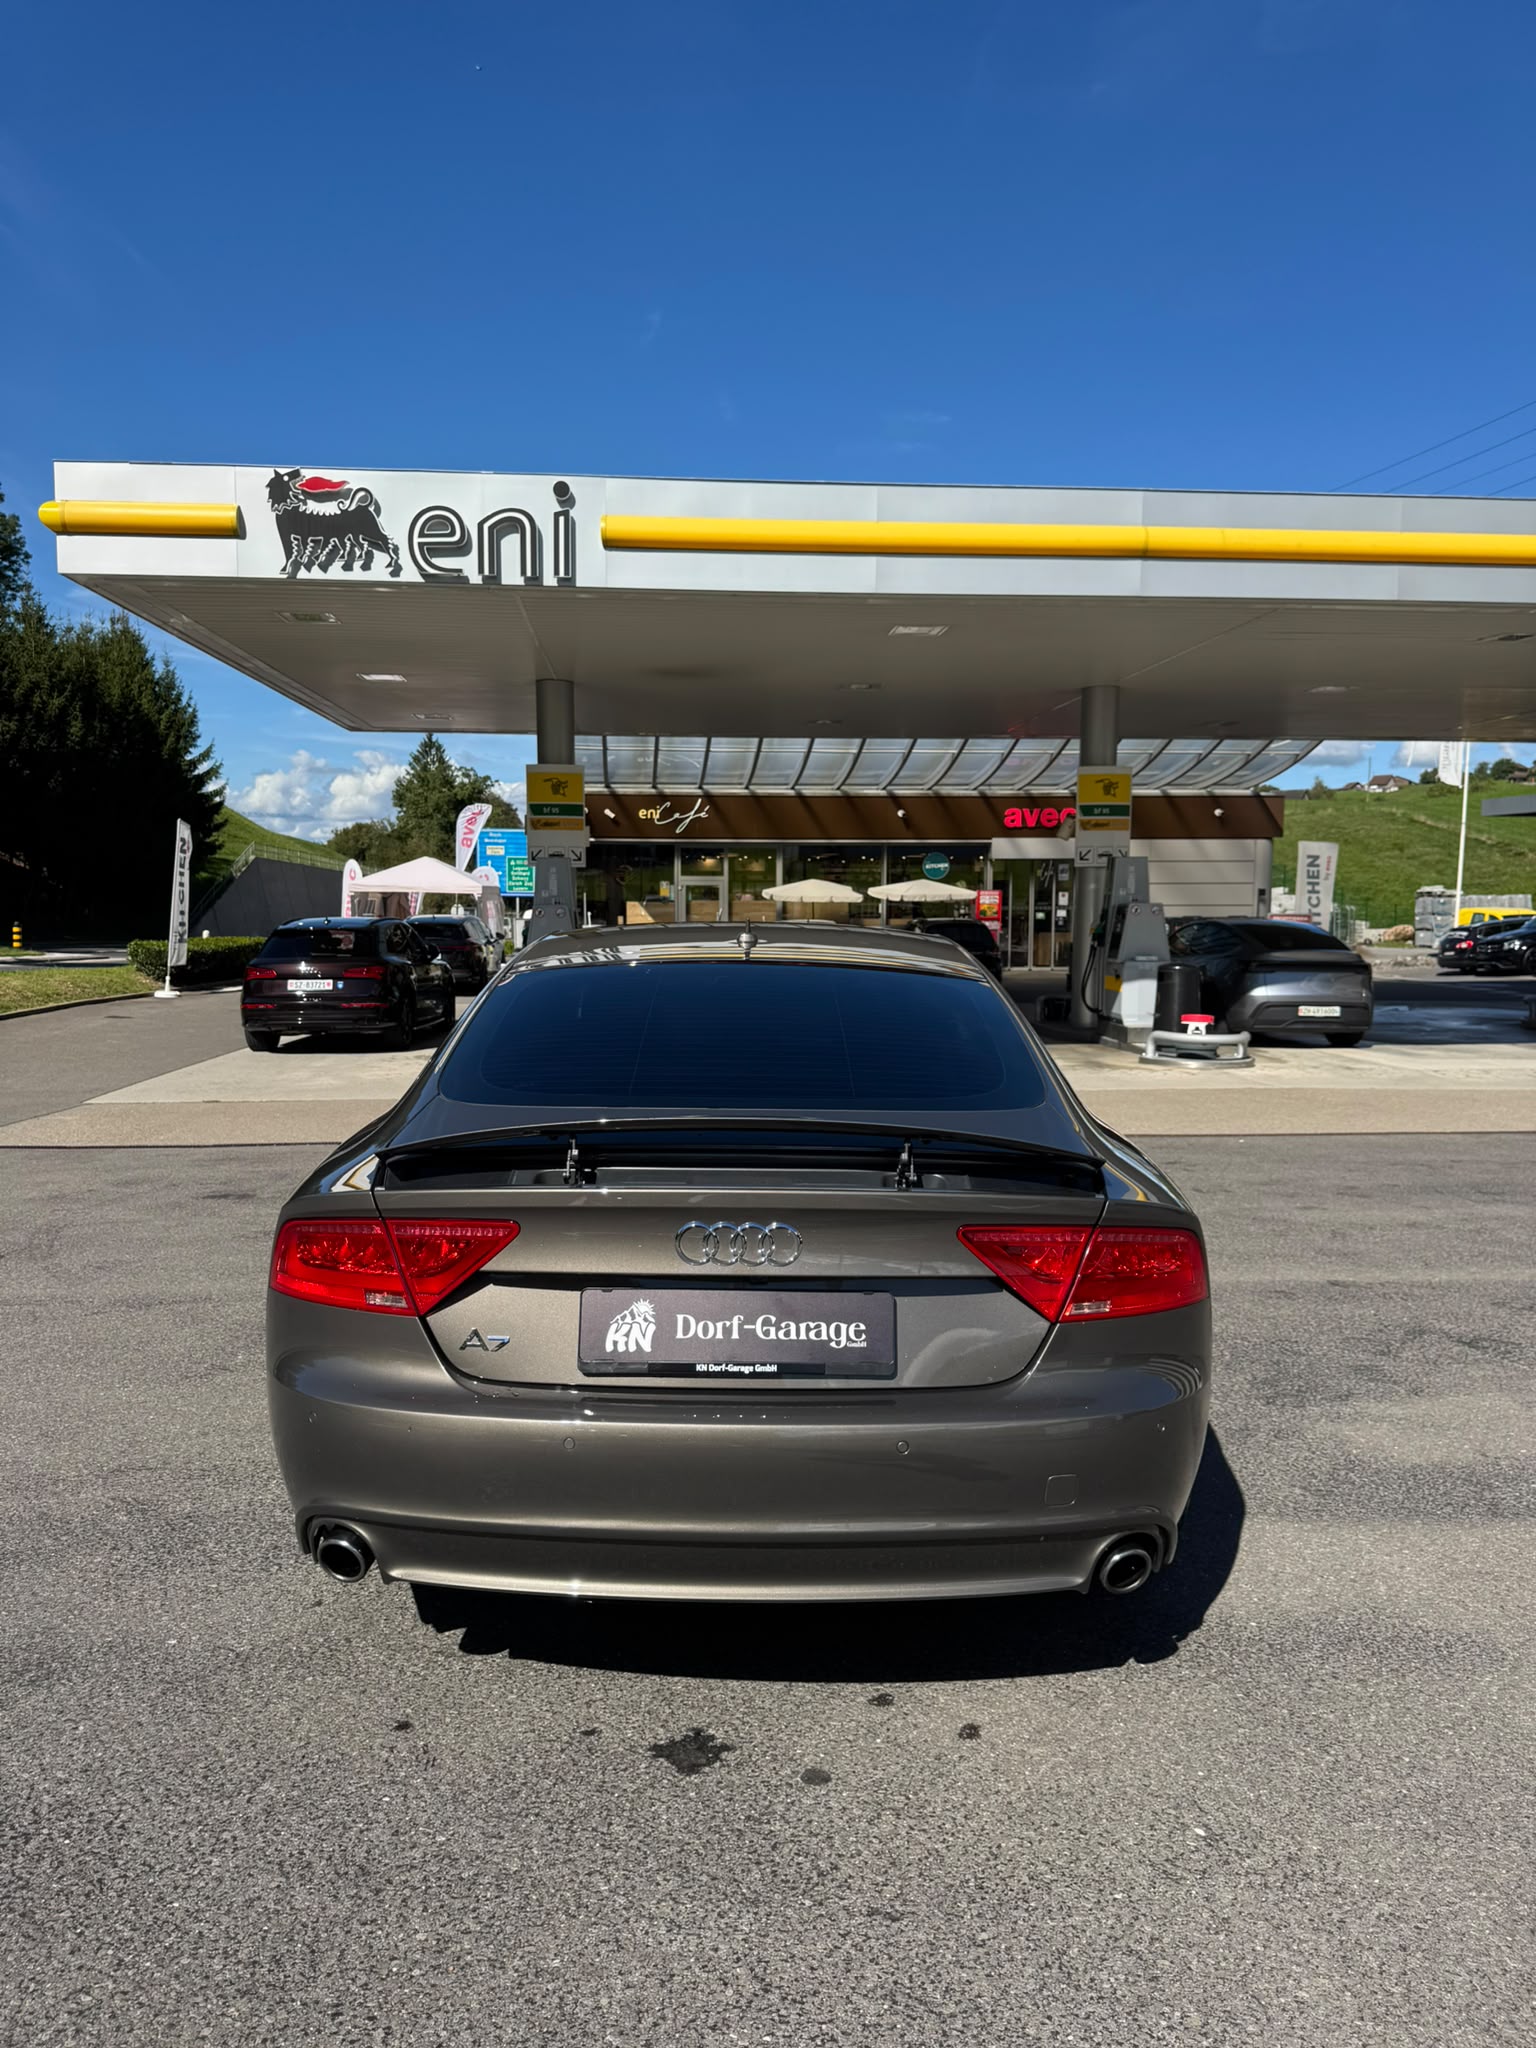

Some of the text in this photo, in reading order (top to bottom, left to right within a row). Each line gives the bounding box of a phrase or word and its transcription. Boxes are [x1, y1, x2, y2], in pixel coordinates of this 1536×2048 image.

[408, 480, 573, 579] eni
[638, 798, 711, 834] eni Café
[1306, 854, 1322, 925] ITCHEN
[459, 1327, 511, 1352] A7
[604, 1314, 867, 1353] KN Dorf-Garage
[695, 1363, 778, 1375] KN Dorf-Garage GmbH
